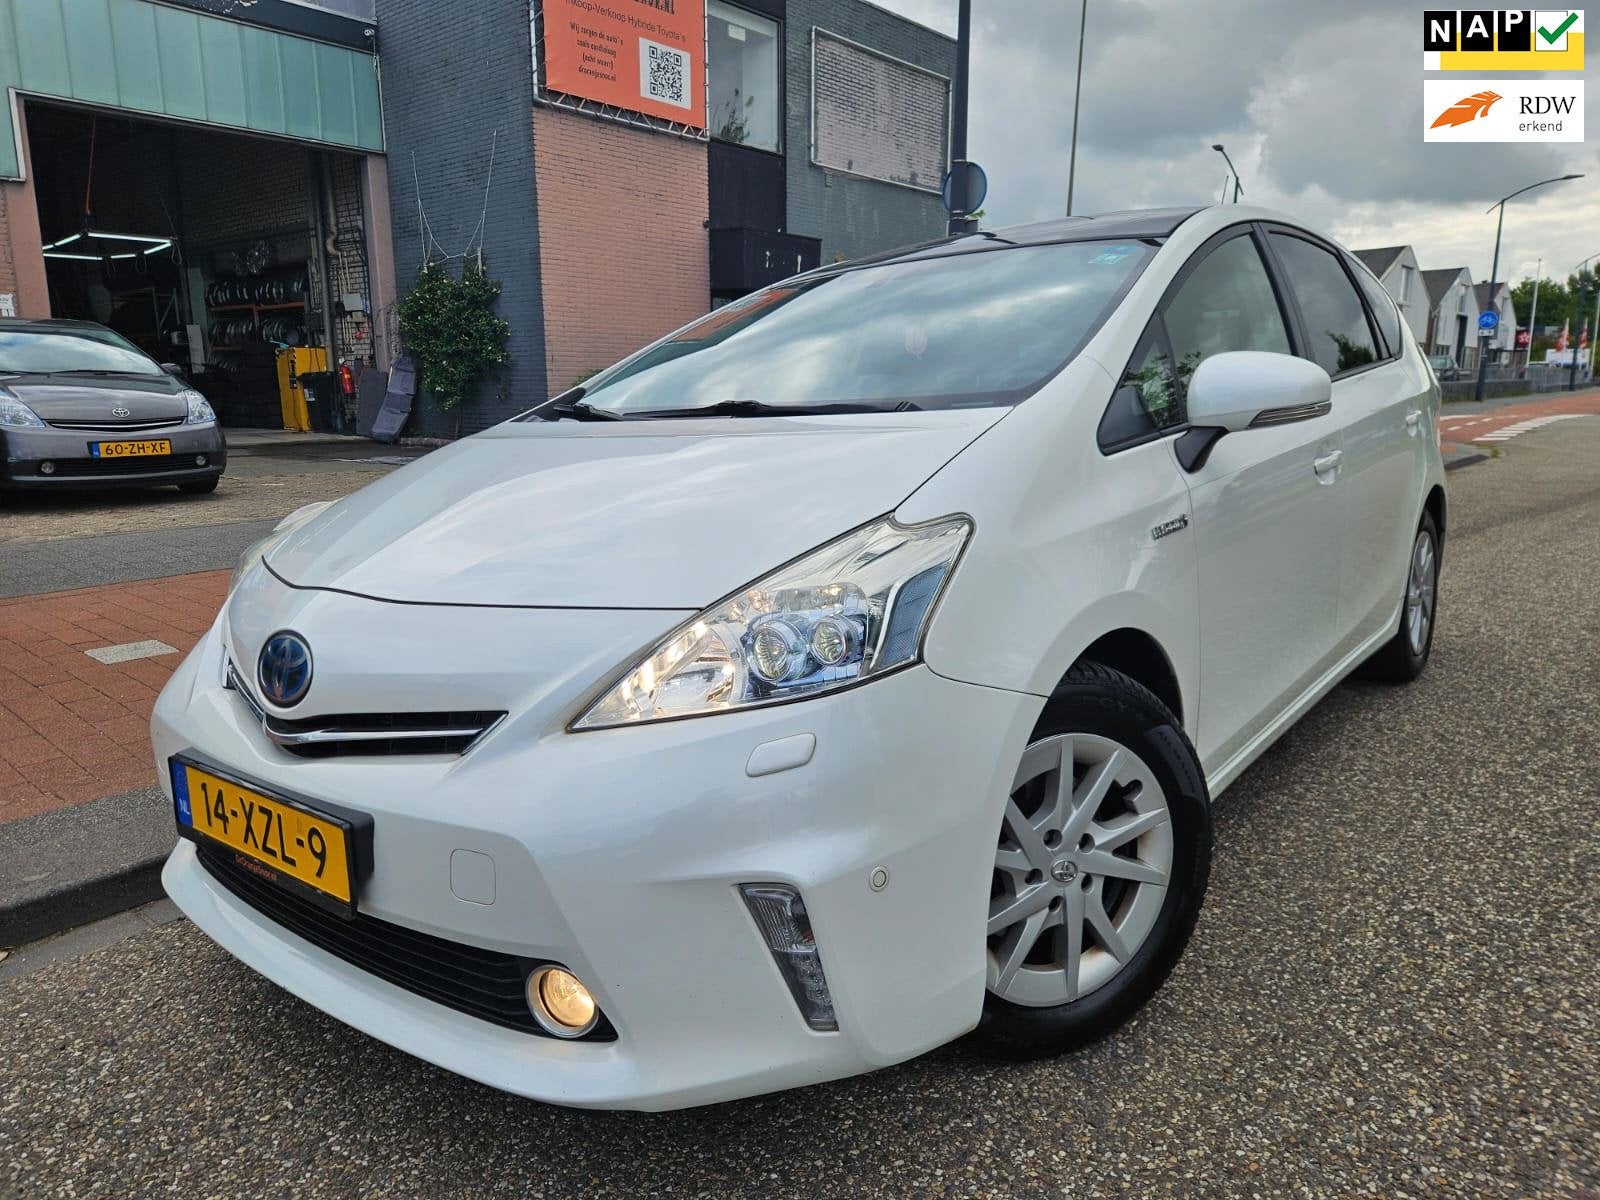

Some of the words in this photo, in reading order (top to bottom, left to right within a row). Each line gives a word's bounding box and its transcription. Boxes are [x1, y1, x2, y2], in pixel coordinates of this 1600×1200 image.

[570, 21, 580, 33] Wij
[628, 15, 656, 32] Hybride
[105, 442, 166, 456] 60-ZH-XF
[179, 797, 191, 815] NL
[201, 781, 327, 879] 14-XZL-9
